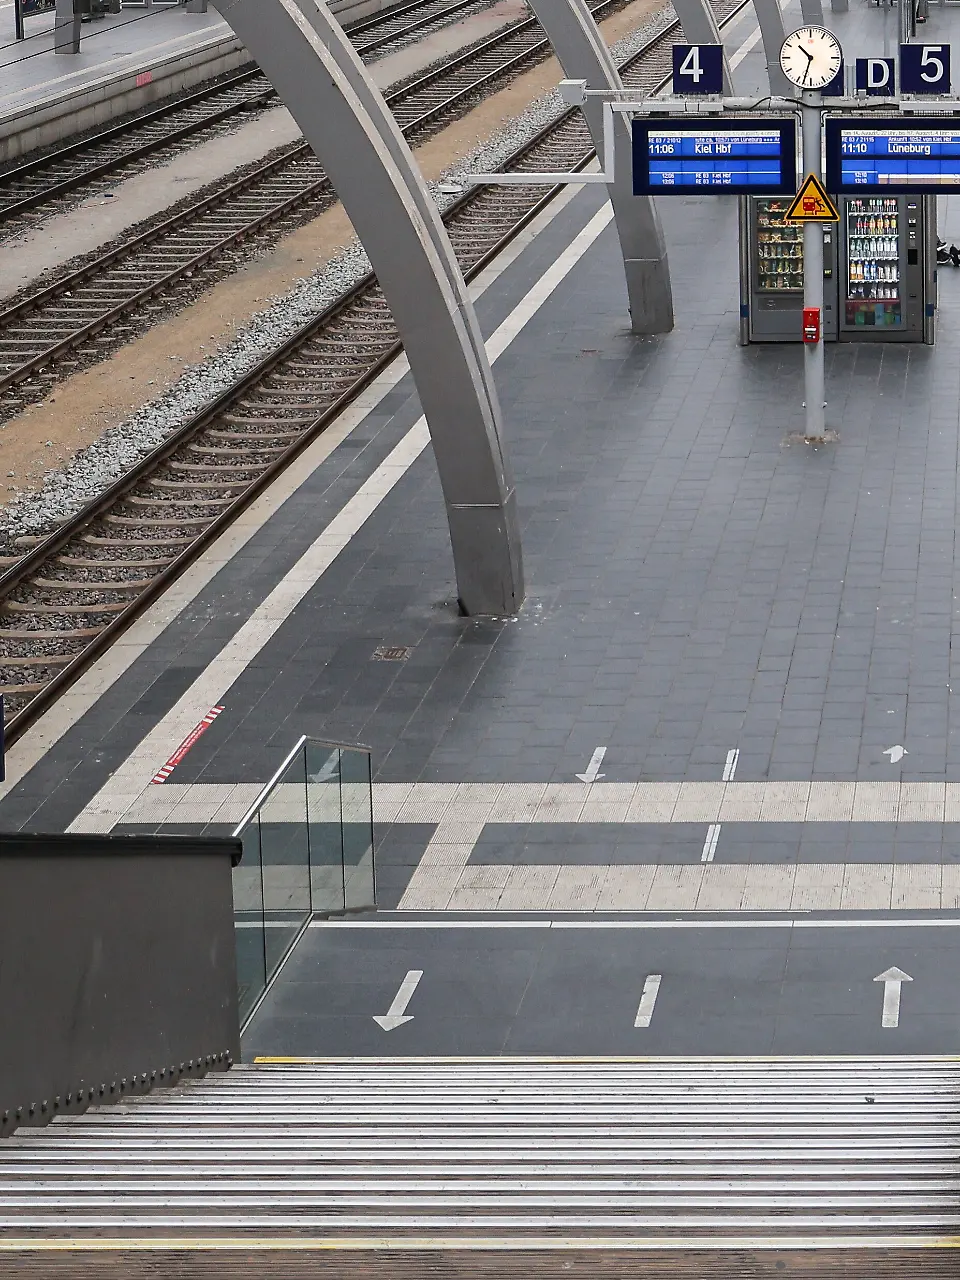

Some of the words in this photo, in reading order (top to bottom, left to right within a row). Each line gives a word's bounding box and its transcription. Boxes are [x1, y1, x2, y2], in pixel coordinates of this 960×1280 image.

[679, 46, 704, 83] 4
[868, 59, 890, 87] D
[920, 46, 944, 82] 5
[649, 144, 674, 154] 11:06
[695, 144, 713, 154] Kiel
[715, 144, 732, 154] Hbf
[842, 143, 868, 153] 11:10
[888, 143, 931, 155] Lüneburg
